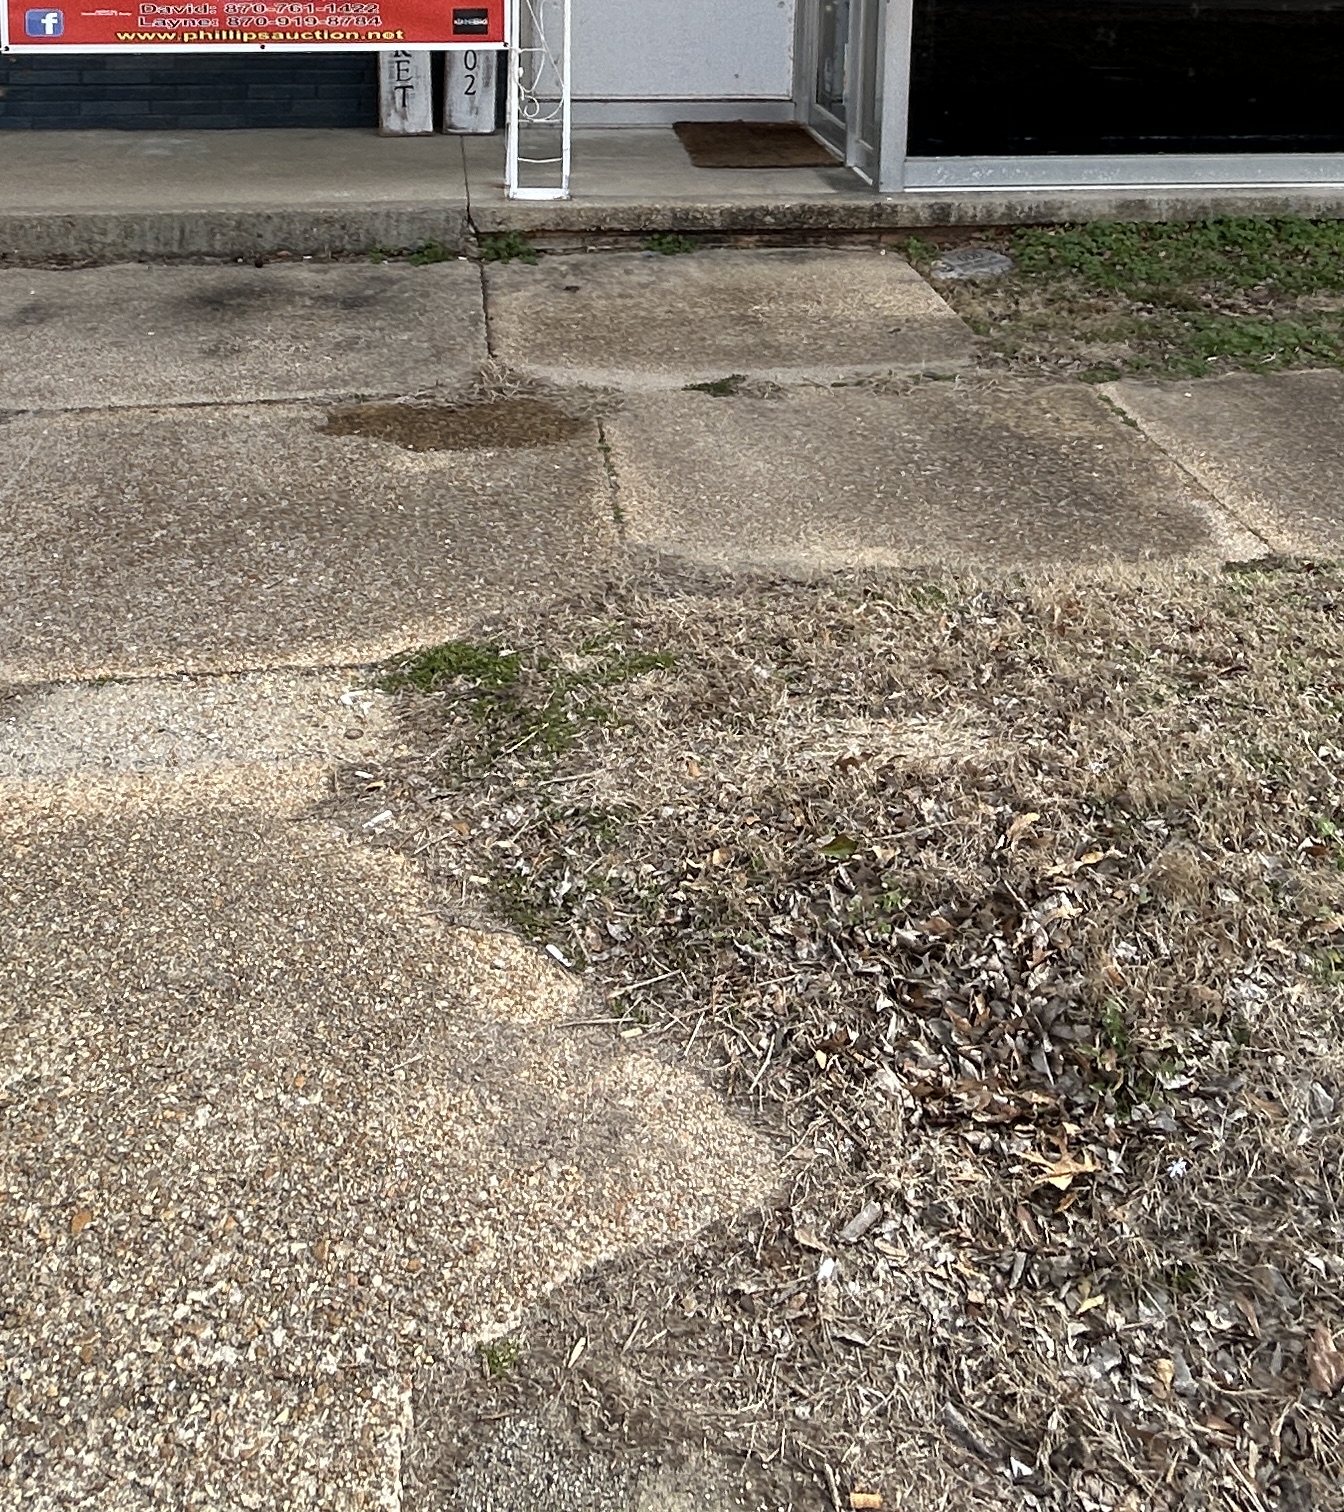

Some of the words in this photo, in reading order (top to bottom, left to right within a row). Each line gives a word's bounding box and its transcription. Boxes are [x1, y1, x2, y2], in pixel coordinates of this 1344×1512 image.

[139, 3, 217, 15] David:
[138, 16, 219, 29] Layne:
[116, 29, 406, 43] www.phillipsauction.net
